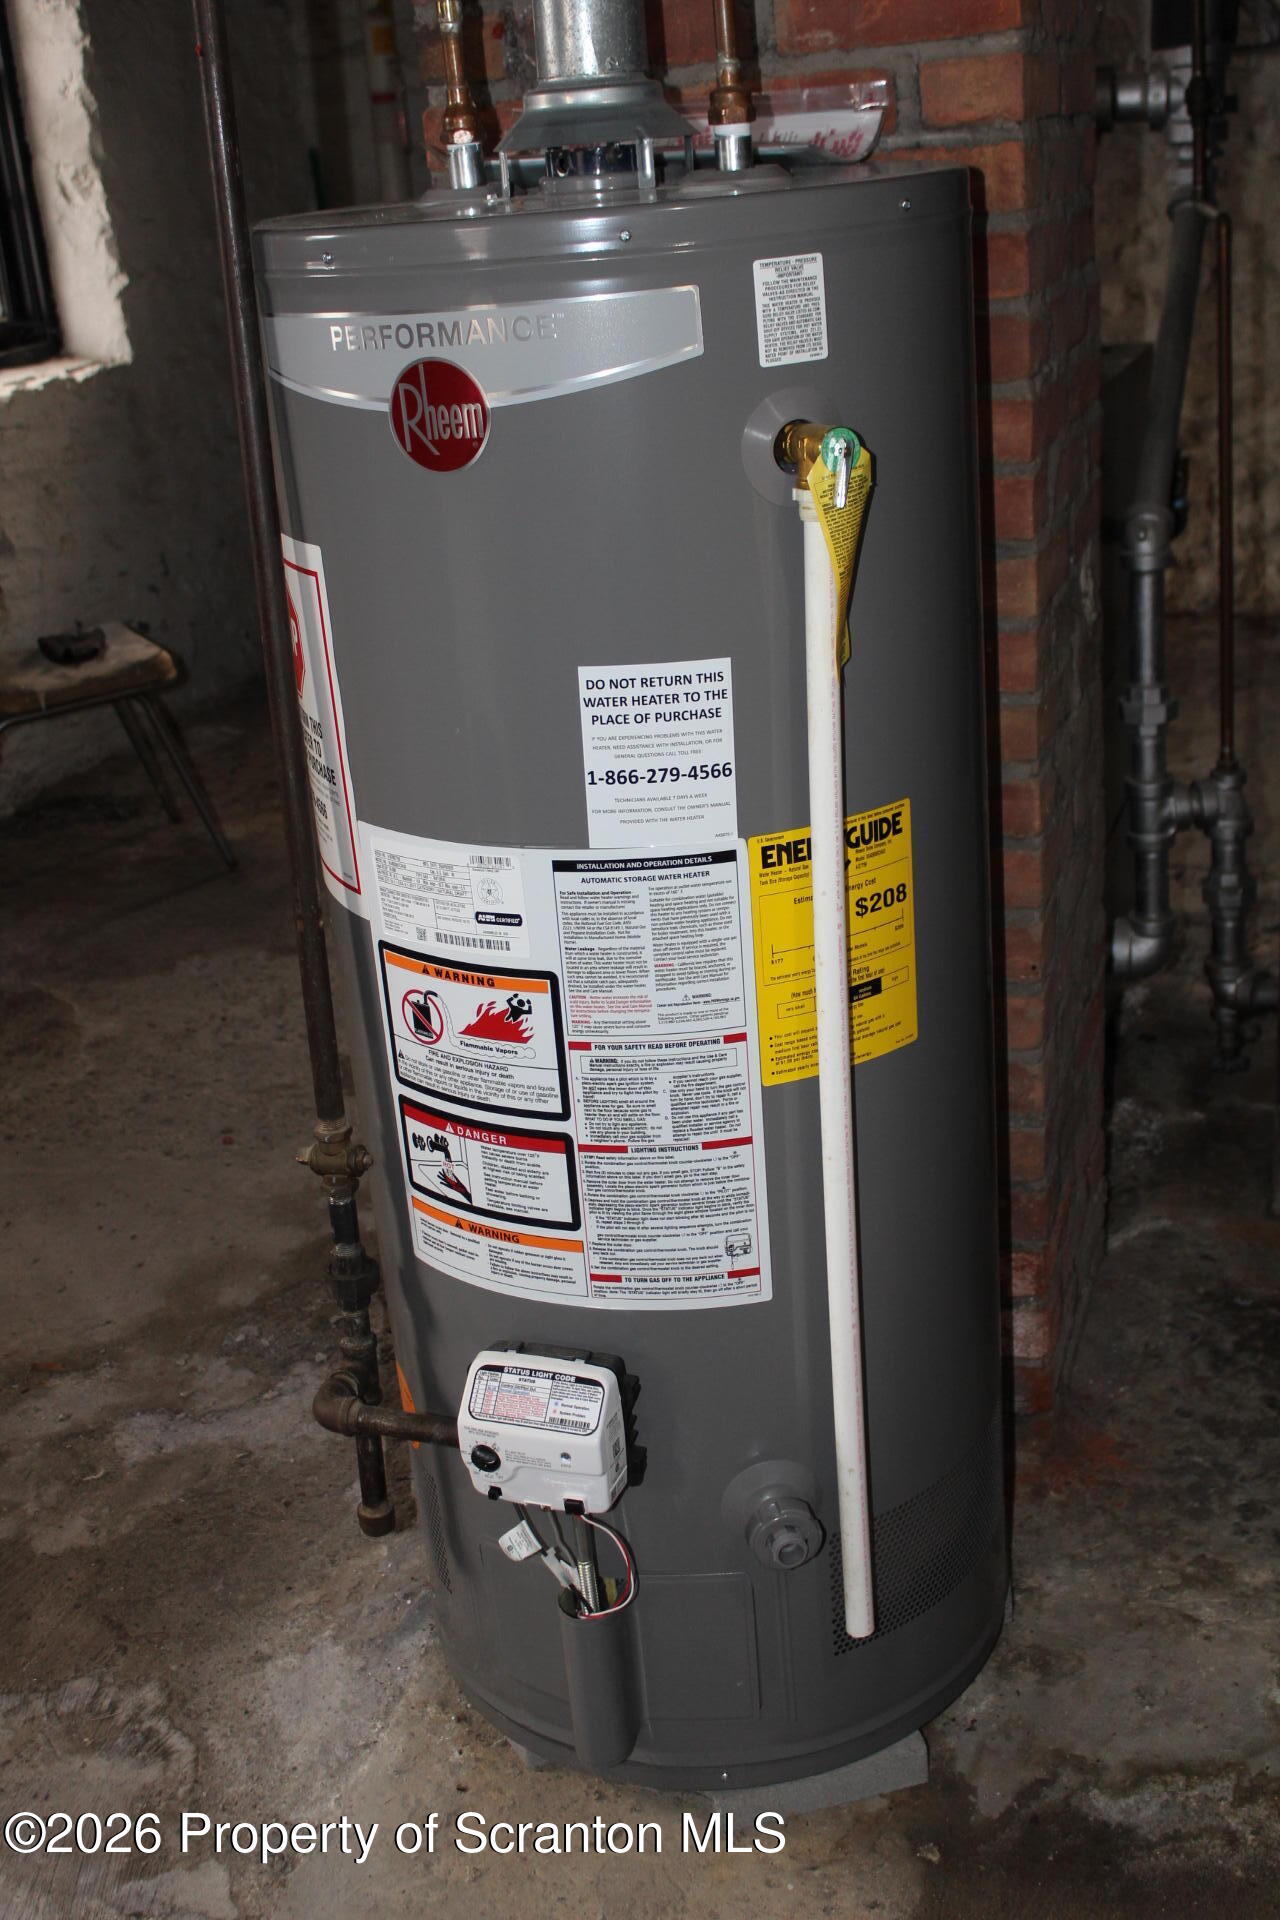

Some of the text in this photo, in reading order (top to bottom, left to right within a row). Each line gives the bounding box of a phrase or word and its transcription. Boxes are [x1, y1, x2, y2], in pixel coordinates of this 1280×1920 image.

[399, 363, 485, 456] Rheem
[586, 671, 724, 690] DO NOT RETURN THIS
[583, 689, 728, 707] WATER HEATER TO THE
[591, 707, 722, 725] PLACE OF PURCHASE
[309, 716, 323, 739] THIS
[313, 738, 322, 758] TO
[588, 762, 732, 785] 1-866-279-4566
[846, 811, 902, 849] GUIDE
[643, 859, 683, 868] OPERATION
[685, 856, 712, 866] DETAILS
[658, 873, 682, 882] WATER
[683, 871, 710, 879] HEATER
[865, 877, 876, 886] Cost
[856, 883, 907, 918] $208
[434, 968, 495, 987] WARNING
[853, 966, 869, 975] Rating
[460, 1041, 493, 1051] Flammable
[689, 1038, 720, 1048] OPERATING
[436, 1058, 448, 1066] result
[456, 1063, 474, 1072] serious
[475, 1067, 490, 1076] injury
[452, 1056, 482, 1067] EXPLOSION
[484, 1062, 508, 1071] HAZARD
[457, 1127, 507, 1144] DANGER
[468, 1223, 520, 1243] WARNING
[694, 1274, 724, 1282] APPLIANCE
[504, 1367, 576, 1383] STATUS LIGHT CODE
